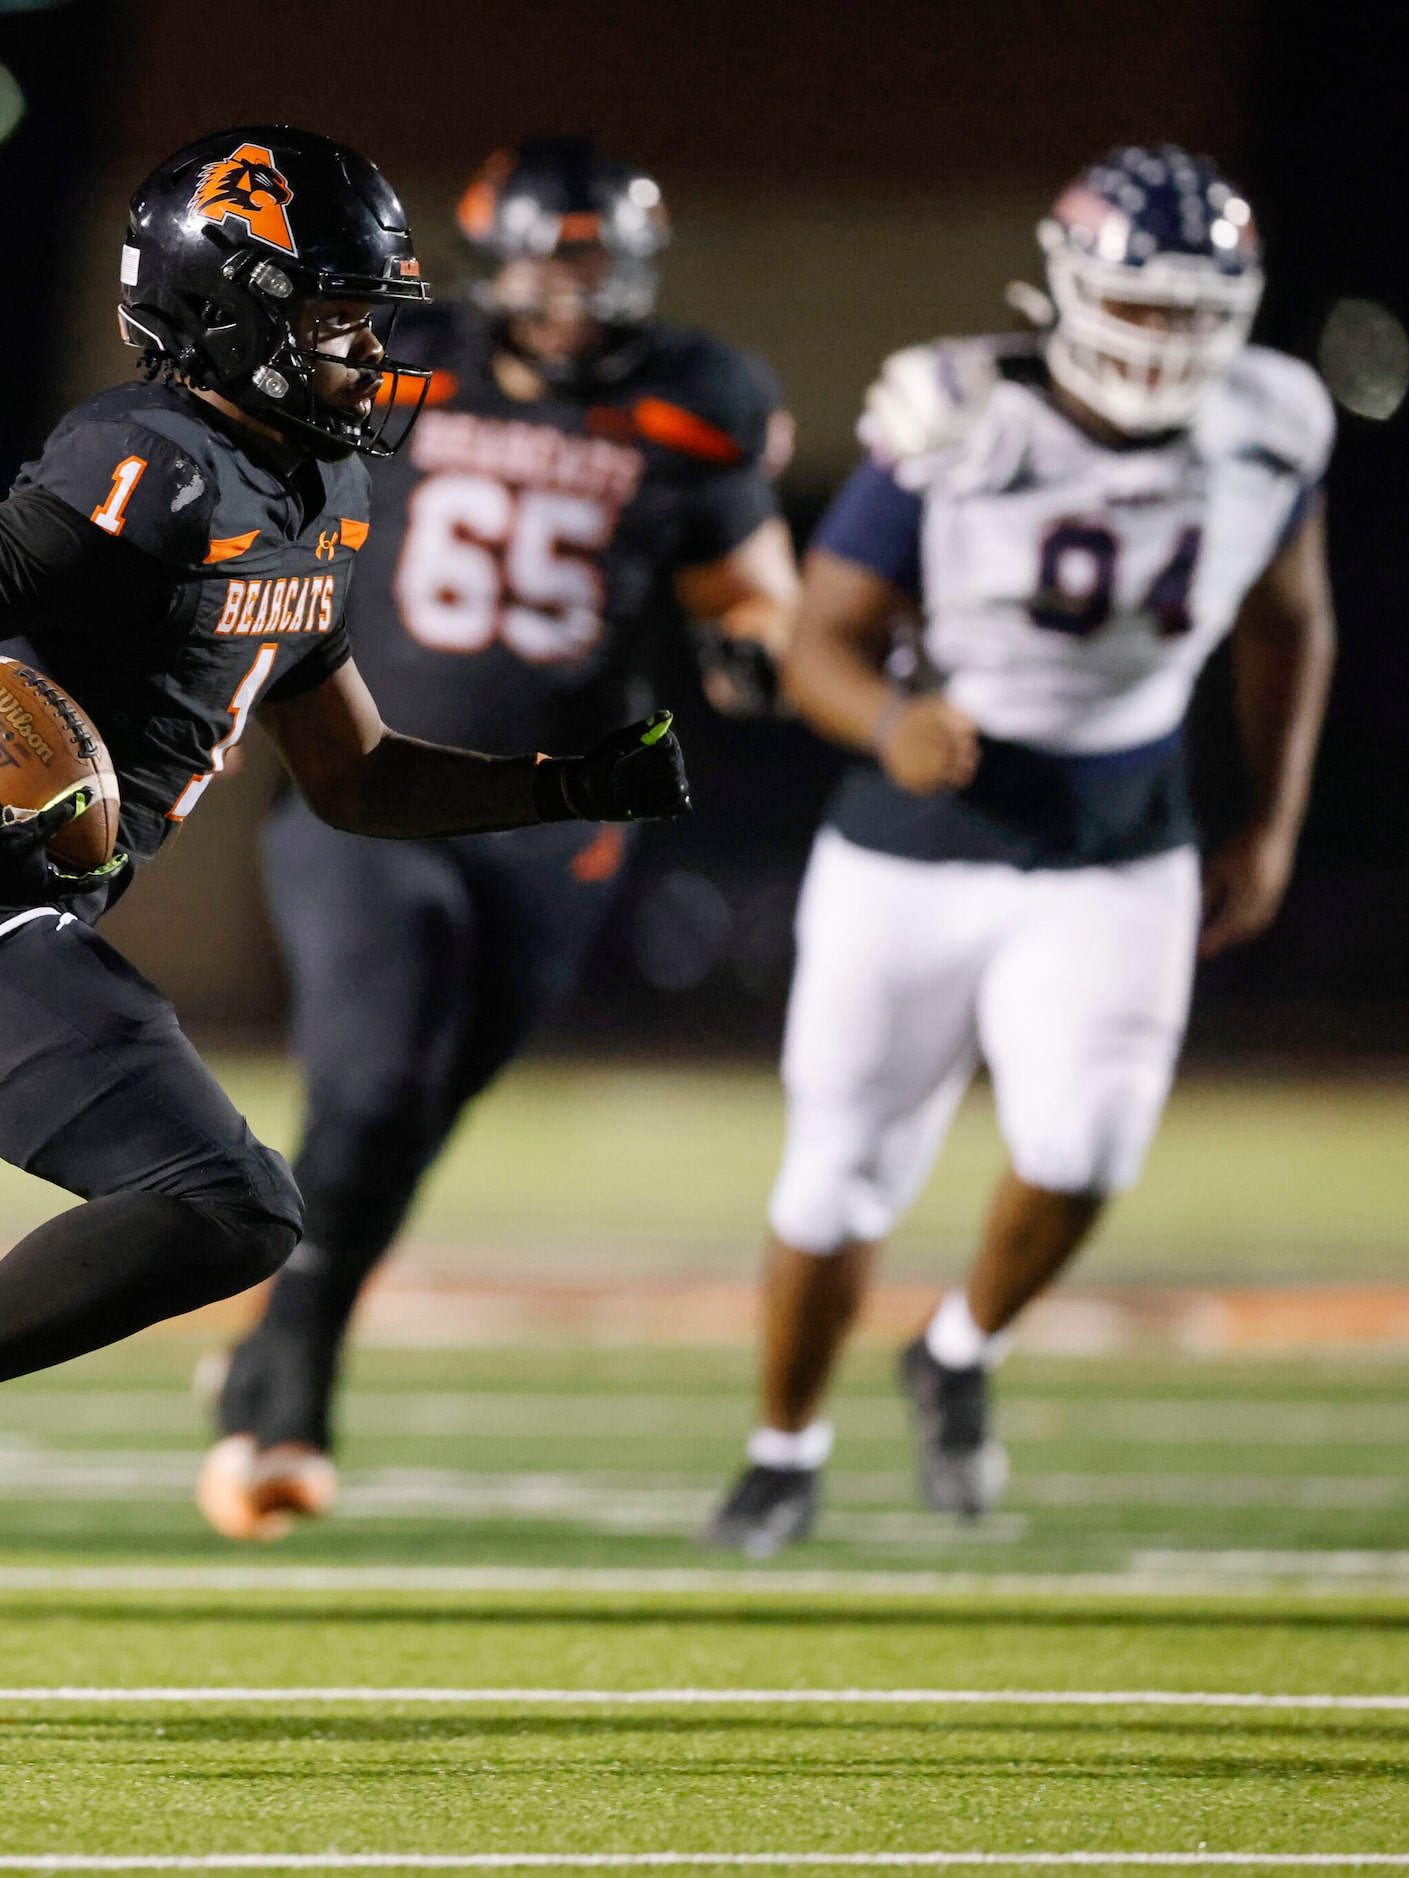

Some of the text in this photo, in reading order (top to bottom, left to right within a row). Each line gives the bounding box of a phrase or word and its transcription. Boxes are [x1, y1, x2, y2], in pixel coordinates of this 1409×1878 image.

[90, 455, 148, 536] 1
[213, 575, 334, 635] BEARCATS
[397, 470, 618, 663] 65
[164, 642, 279, 822] 1
